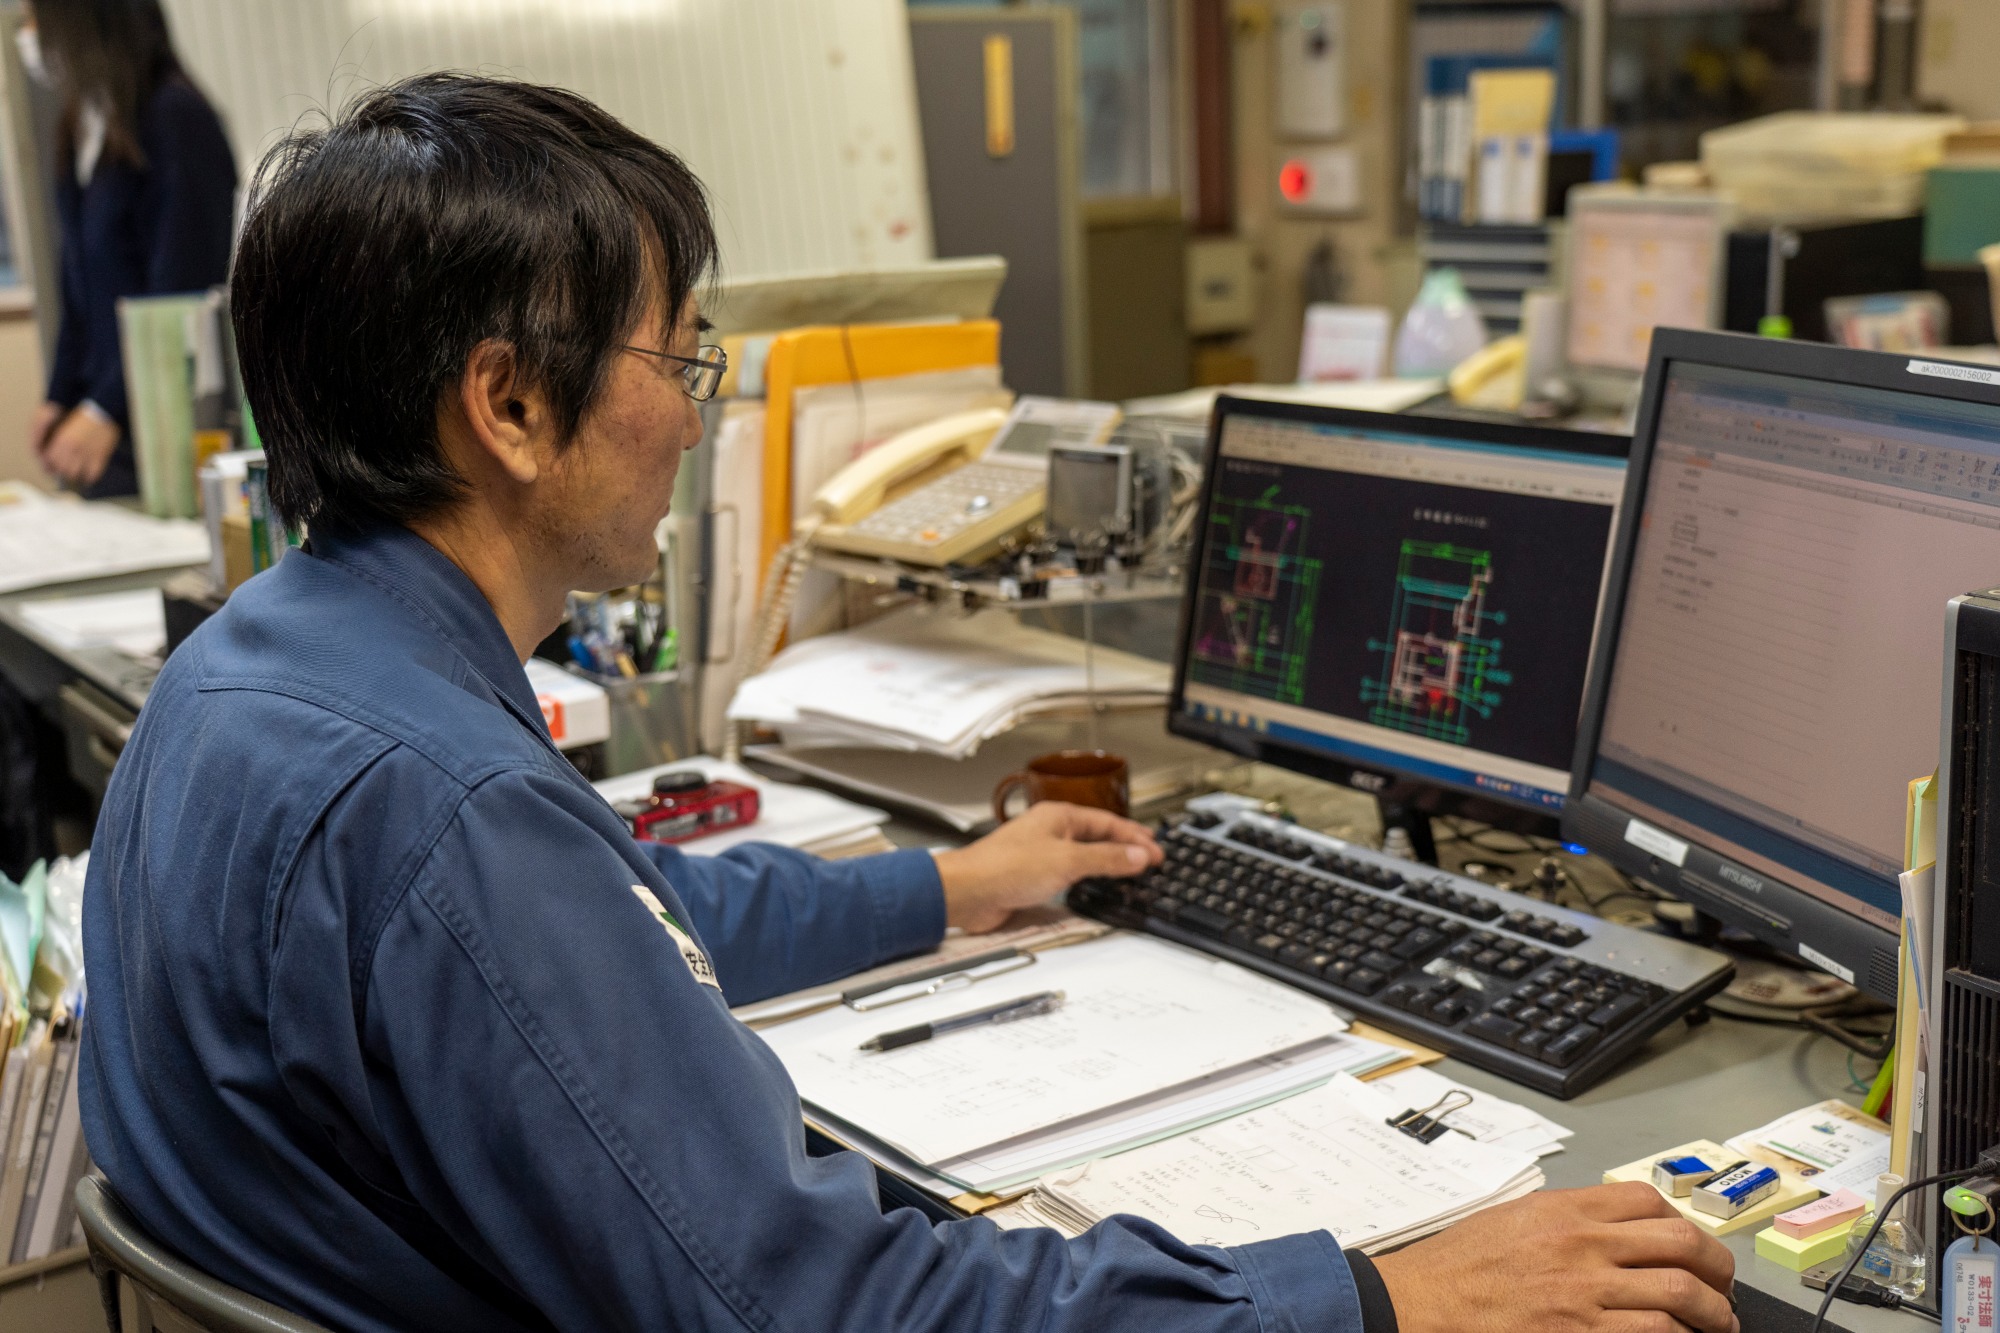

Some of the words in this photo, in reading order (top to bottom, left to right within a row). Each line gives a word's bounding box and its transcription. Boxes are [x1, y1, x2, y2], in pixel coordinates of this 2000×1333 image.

[1719, 1169, 1753, 1186] MONO
[1967, 1273, 1976, 1316] W0133-02
[1978, 1275, 1993, 1328] 実寸法師
